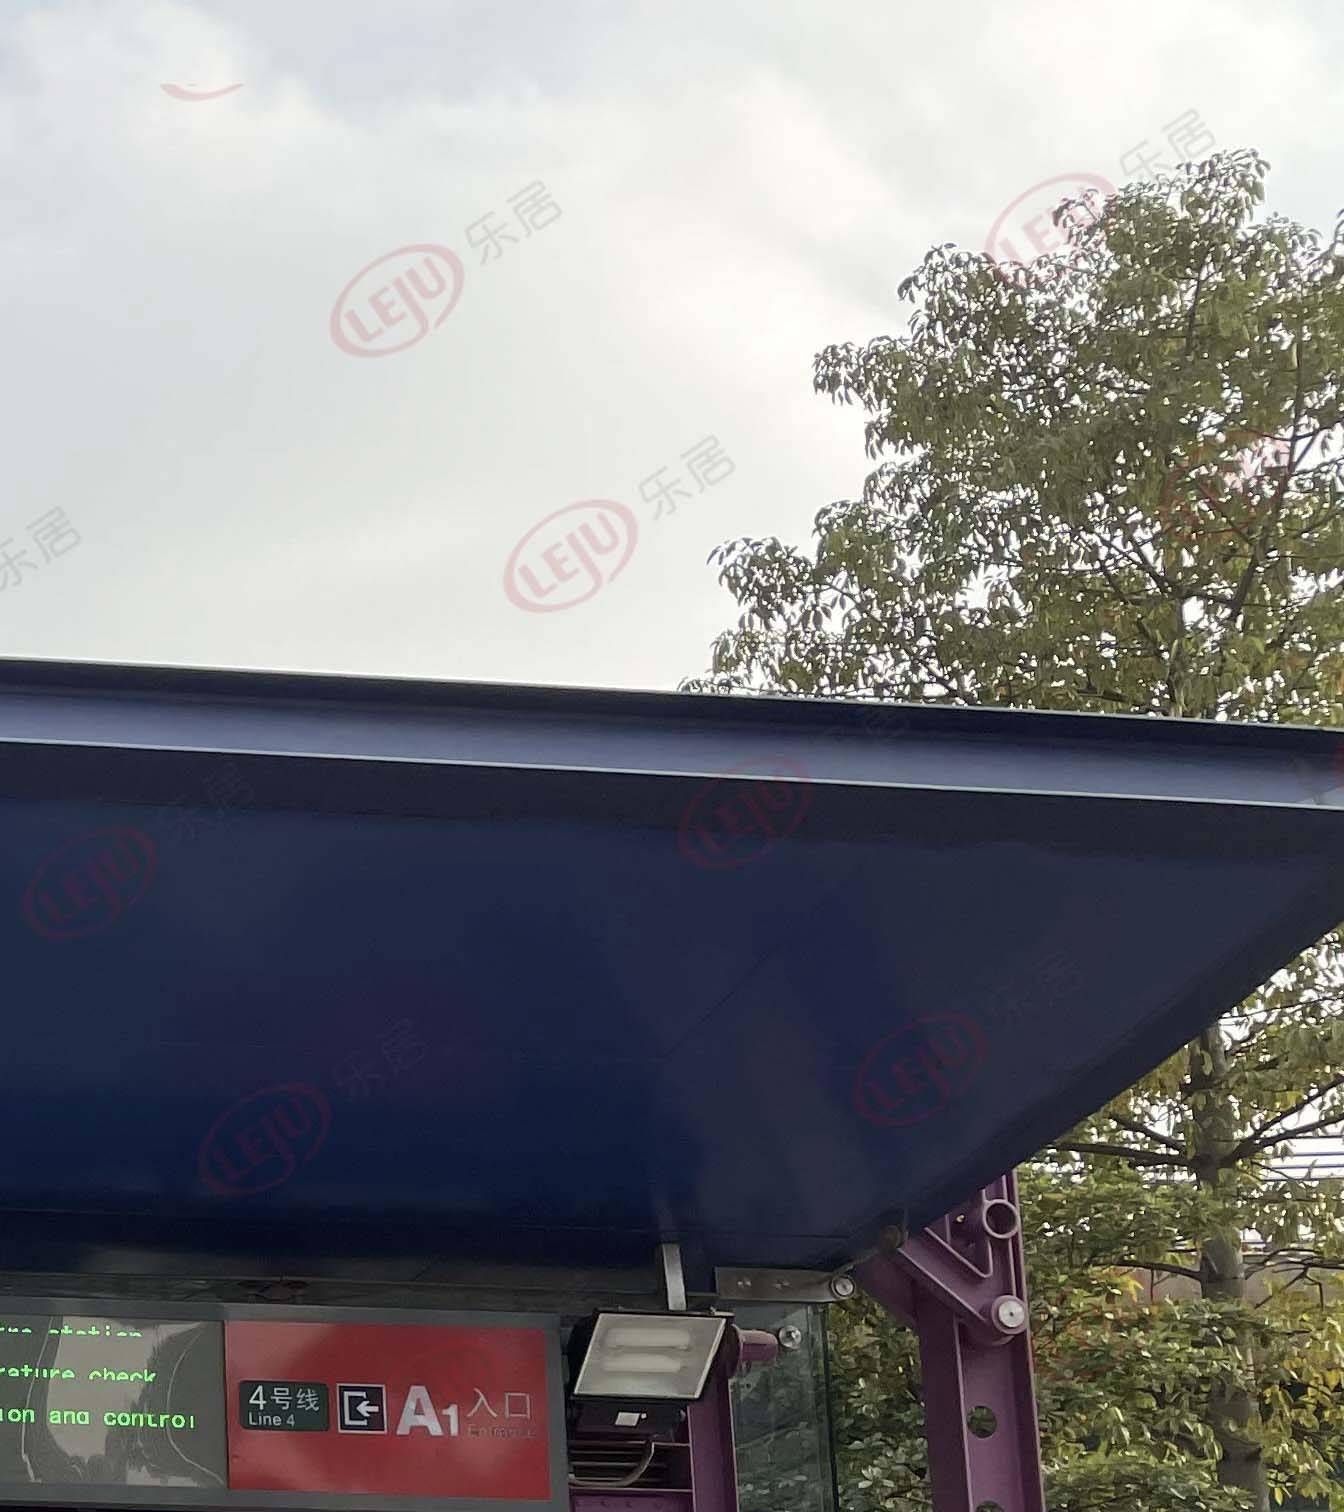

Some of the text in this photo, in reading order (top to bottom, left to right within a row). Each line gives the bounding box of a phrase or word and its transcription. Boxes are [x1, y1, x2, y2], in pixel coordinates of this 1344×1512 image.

[249, 1385, 320, 1412] 4号线
[396, 1385, 532, 1437] A1 入口
[248, 1412, 296, 1427] Line 4
